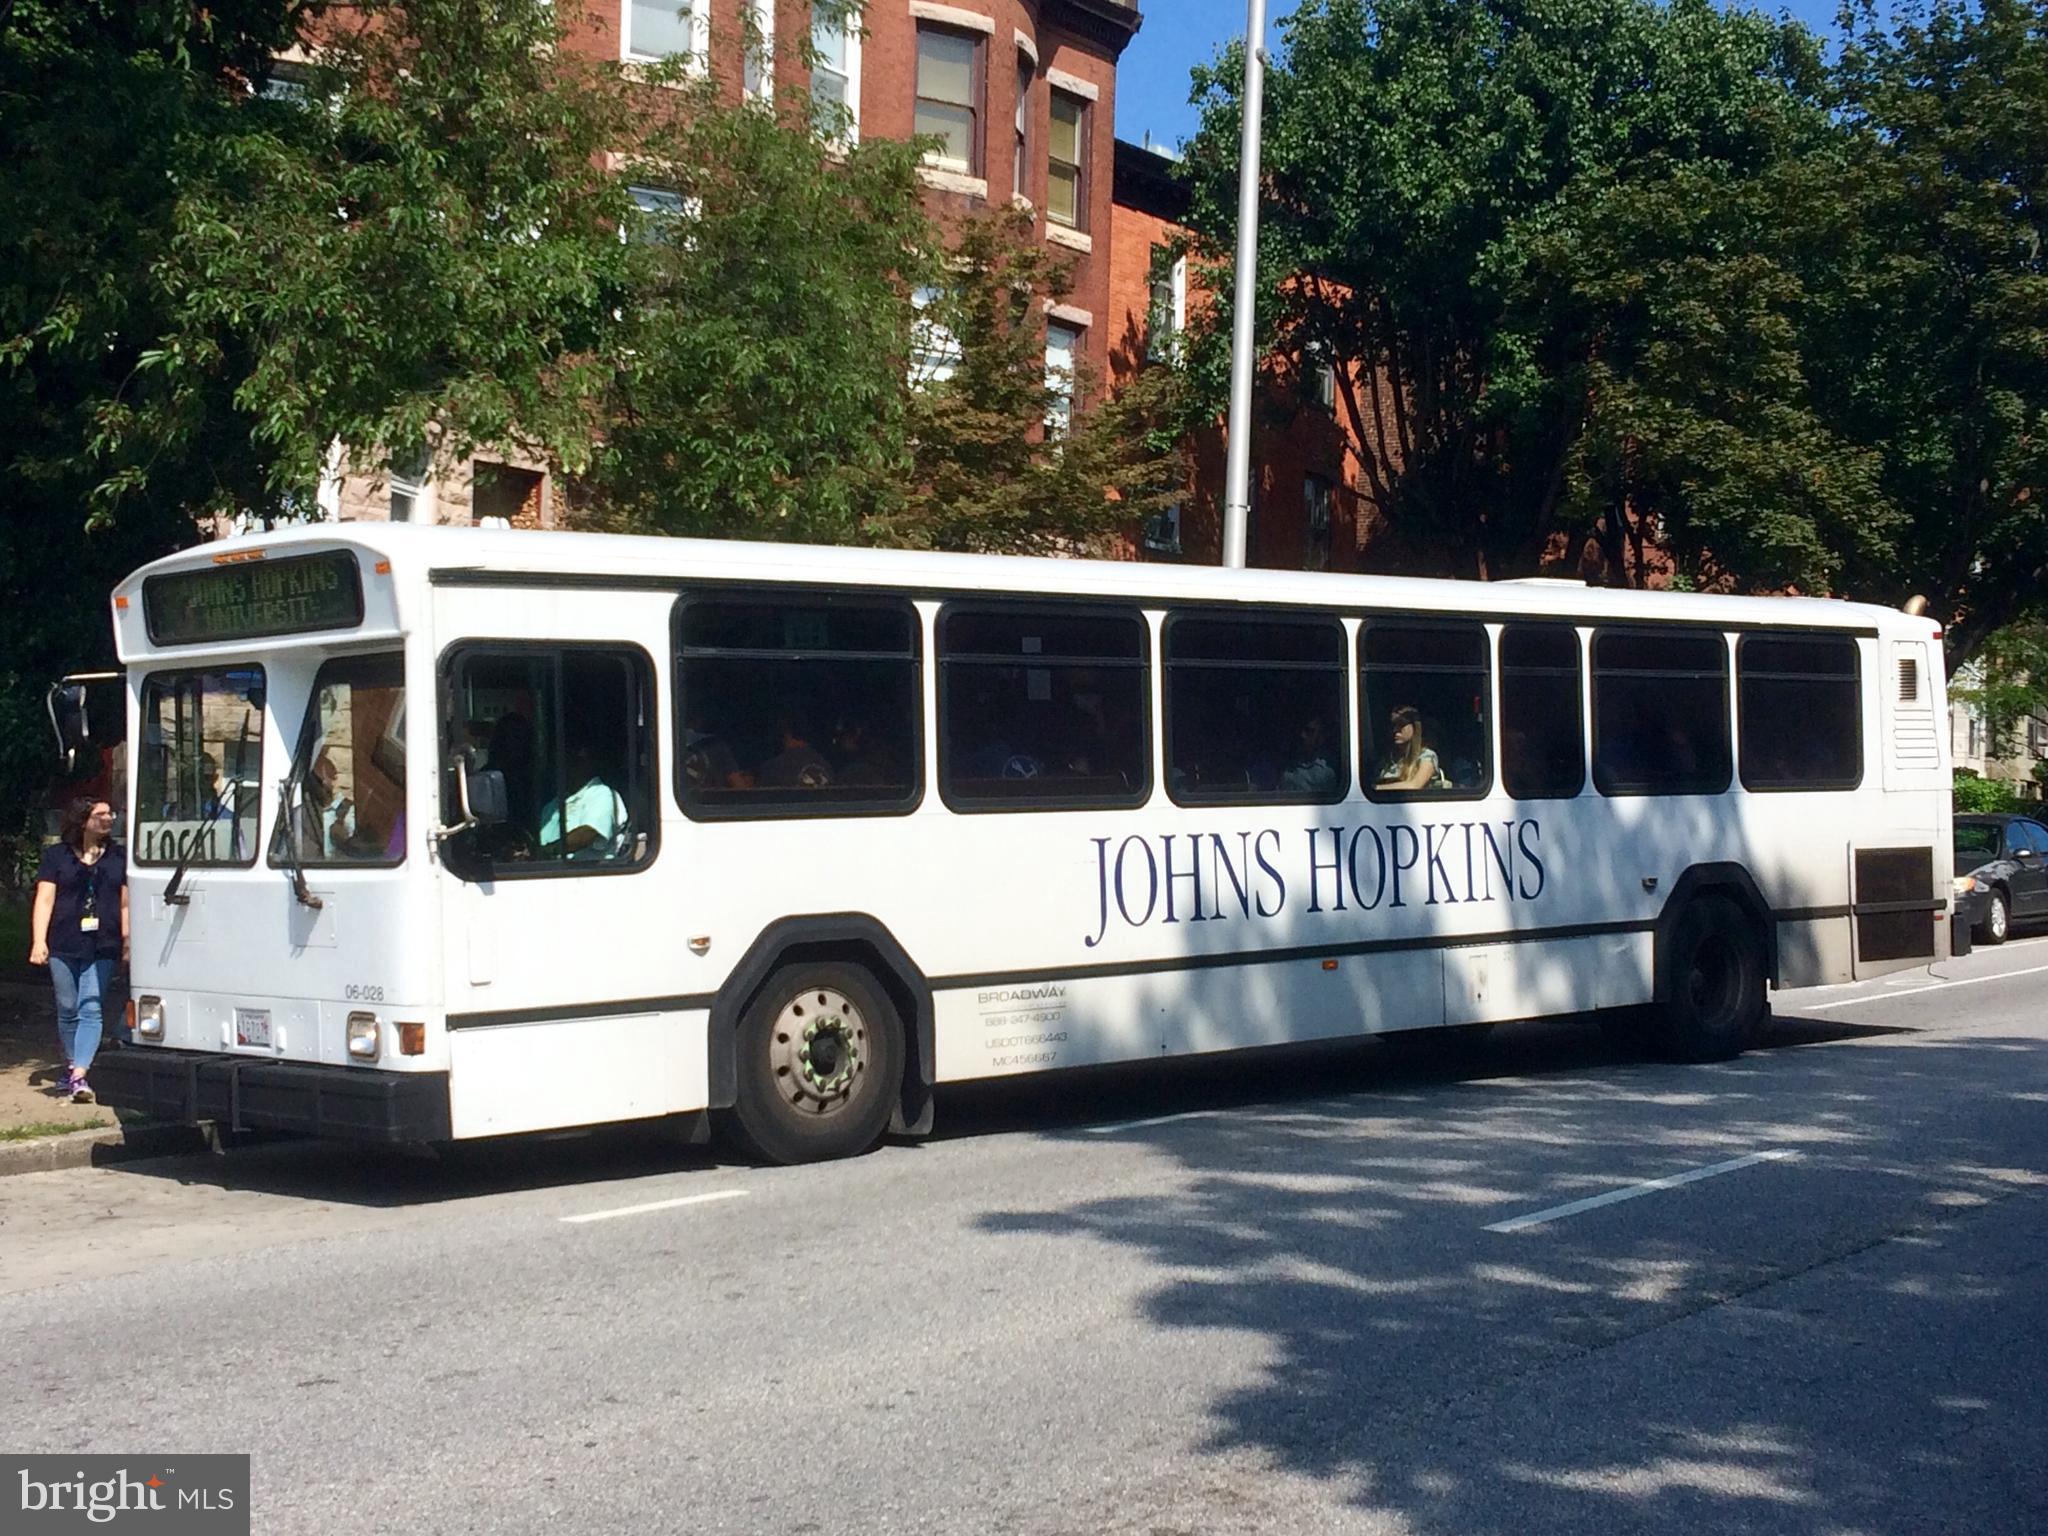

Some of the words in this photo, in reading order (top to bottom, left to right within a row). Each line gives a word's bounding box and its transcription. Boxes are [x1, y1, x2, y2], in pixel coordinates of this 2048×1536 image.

[1085, 828, 1286, 947] JOHNS
[1304, 818, 1545, 913] HOPKINS
[345, 984, 384, 1001] 06-028
[978, 986, 1066, 1004] BROADWAY
